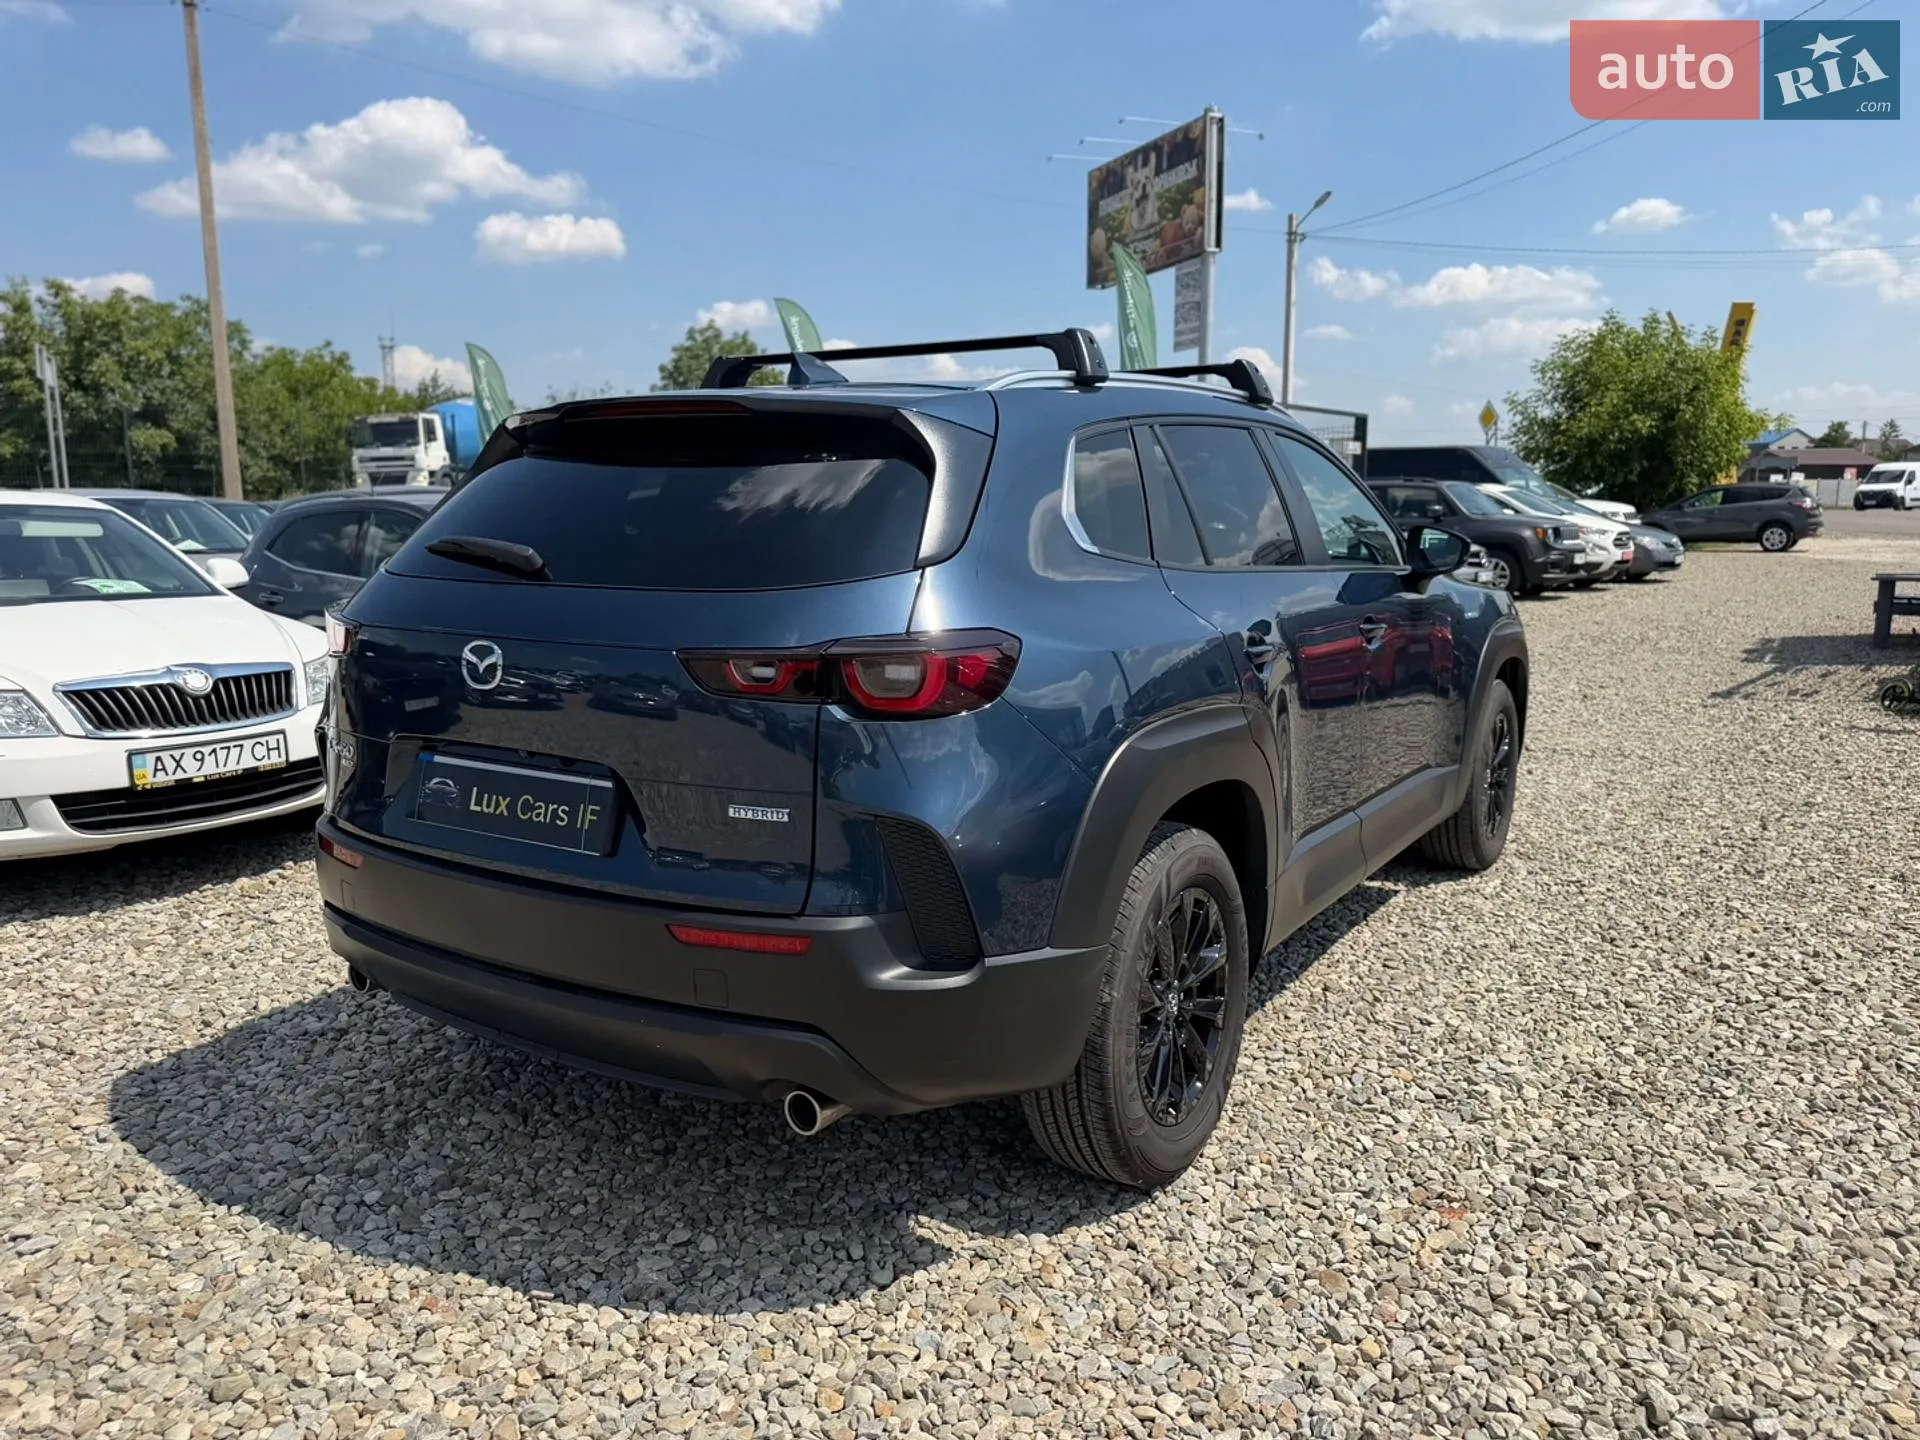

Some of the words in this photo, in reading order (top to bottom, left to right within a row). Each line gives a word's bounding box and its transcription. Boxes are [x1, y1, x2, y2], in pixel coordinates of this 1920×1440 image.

[152, 752, 188, 779] AX
[192, 744, 244, 772] 9177
[250, 738, 282, 762] CH
[469, 786, 511, 817] Lux
[516, 794, 569, 827] Cars
[576, 803, 601, 830] IF
[731, 806, 787, 821] HYBRID
